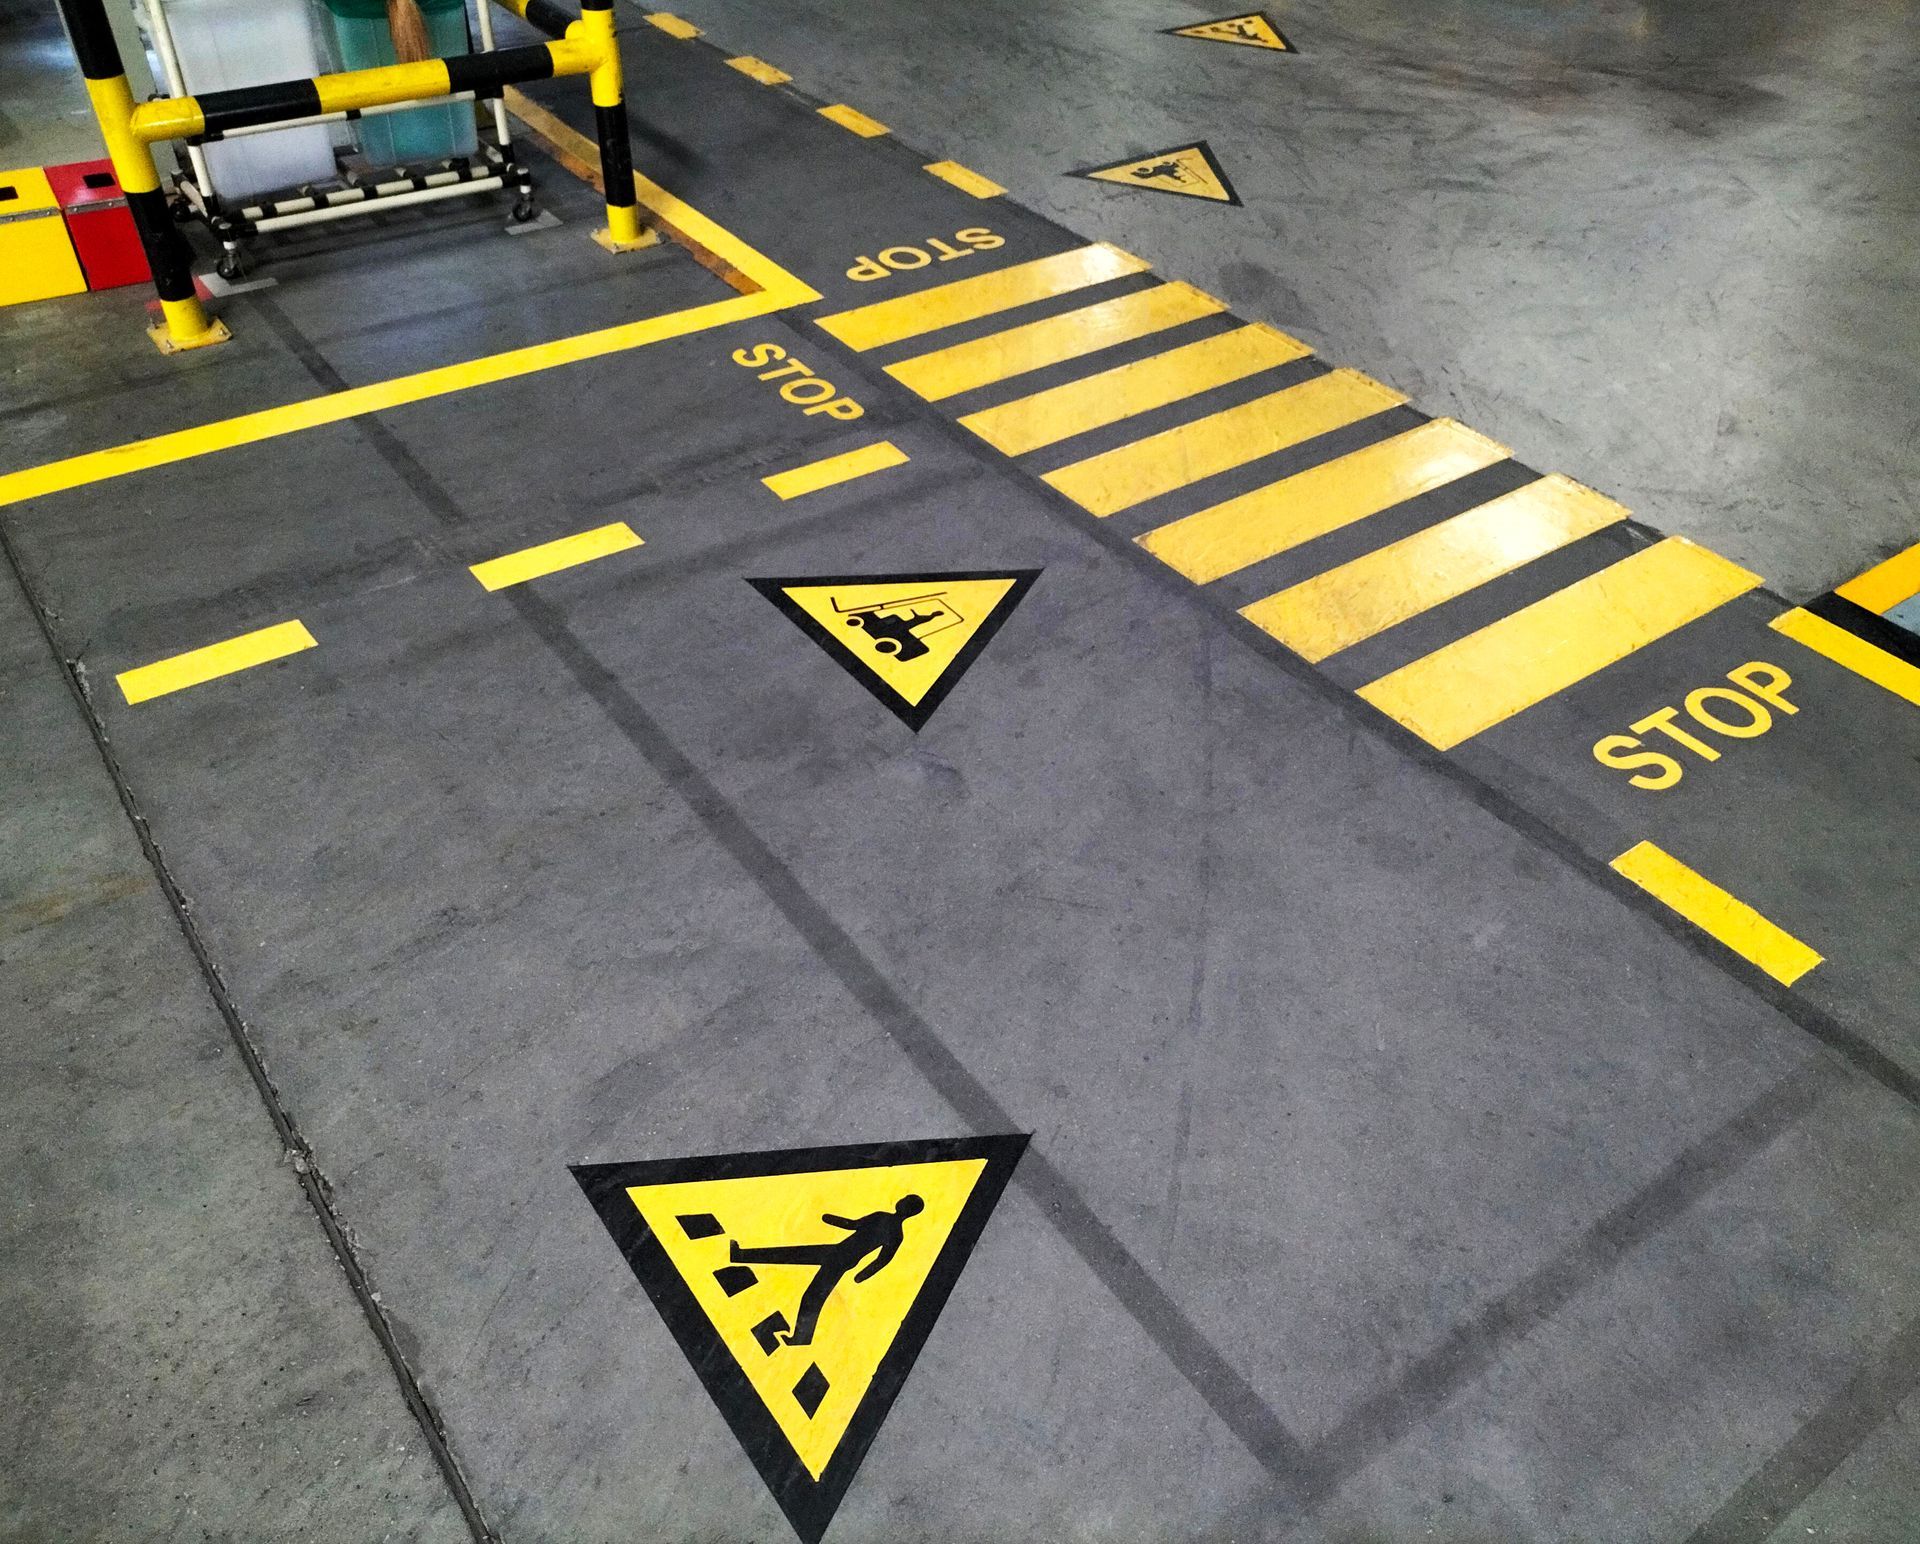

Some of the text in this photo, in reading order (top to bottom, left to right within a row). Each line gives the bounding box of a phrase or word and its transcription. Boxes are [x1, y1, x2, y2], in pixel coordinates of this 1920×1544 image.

[846, 226, 1006, 283] STOP
[731, 341, 865, 421] STOP
[1592, 660, 1800, 791] STOP
